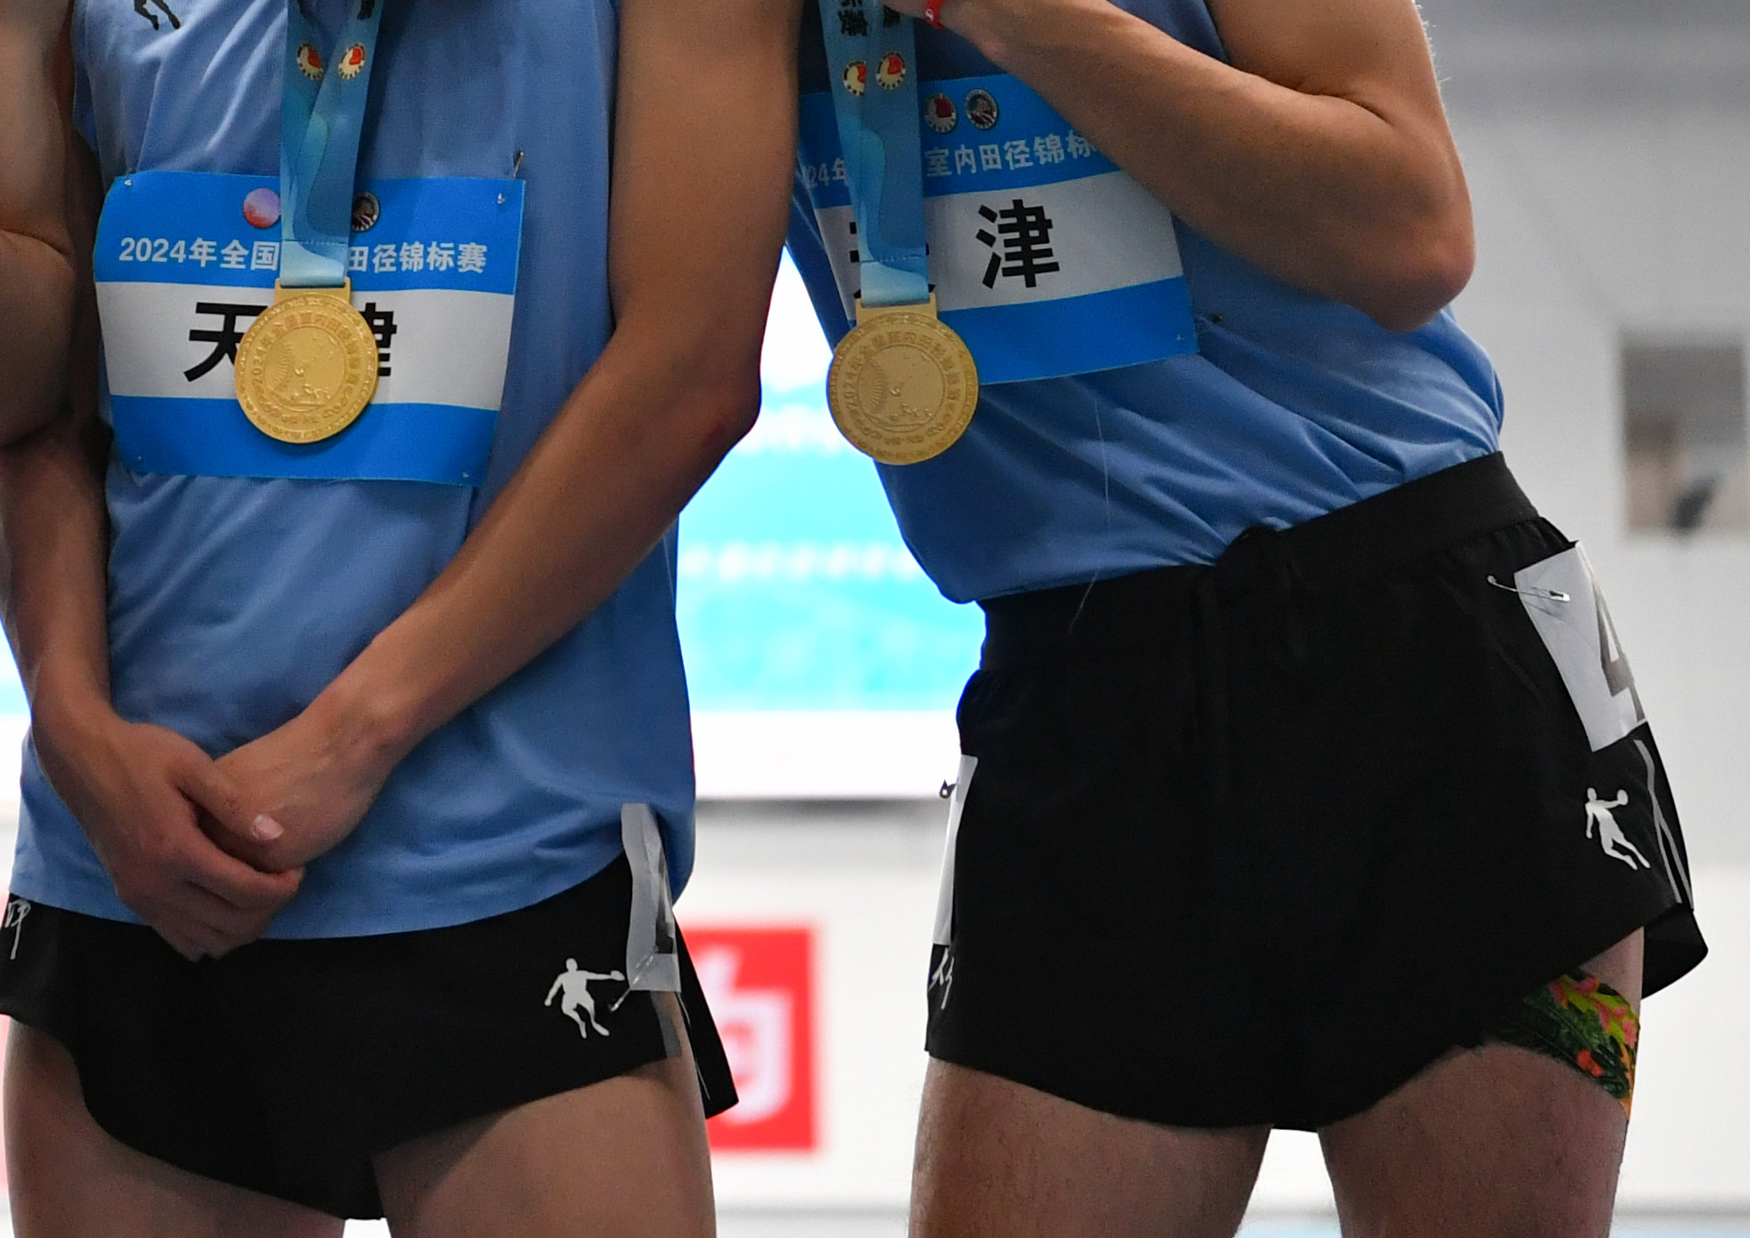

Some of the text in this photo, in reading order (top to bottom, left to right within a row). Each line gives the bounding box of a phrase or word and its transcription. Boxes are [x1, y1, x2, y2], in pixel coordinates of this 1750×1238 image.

[118, 236, 488, 274] 2024年全国田径锦标赛
